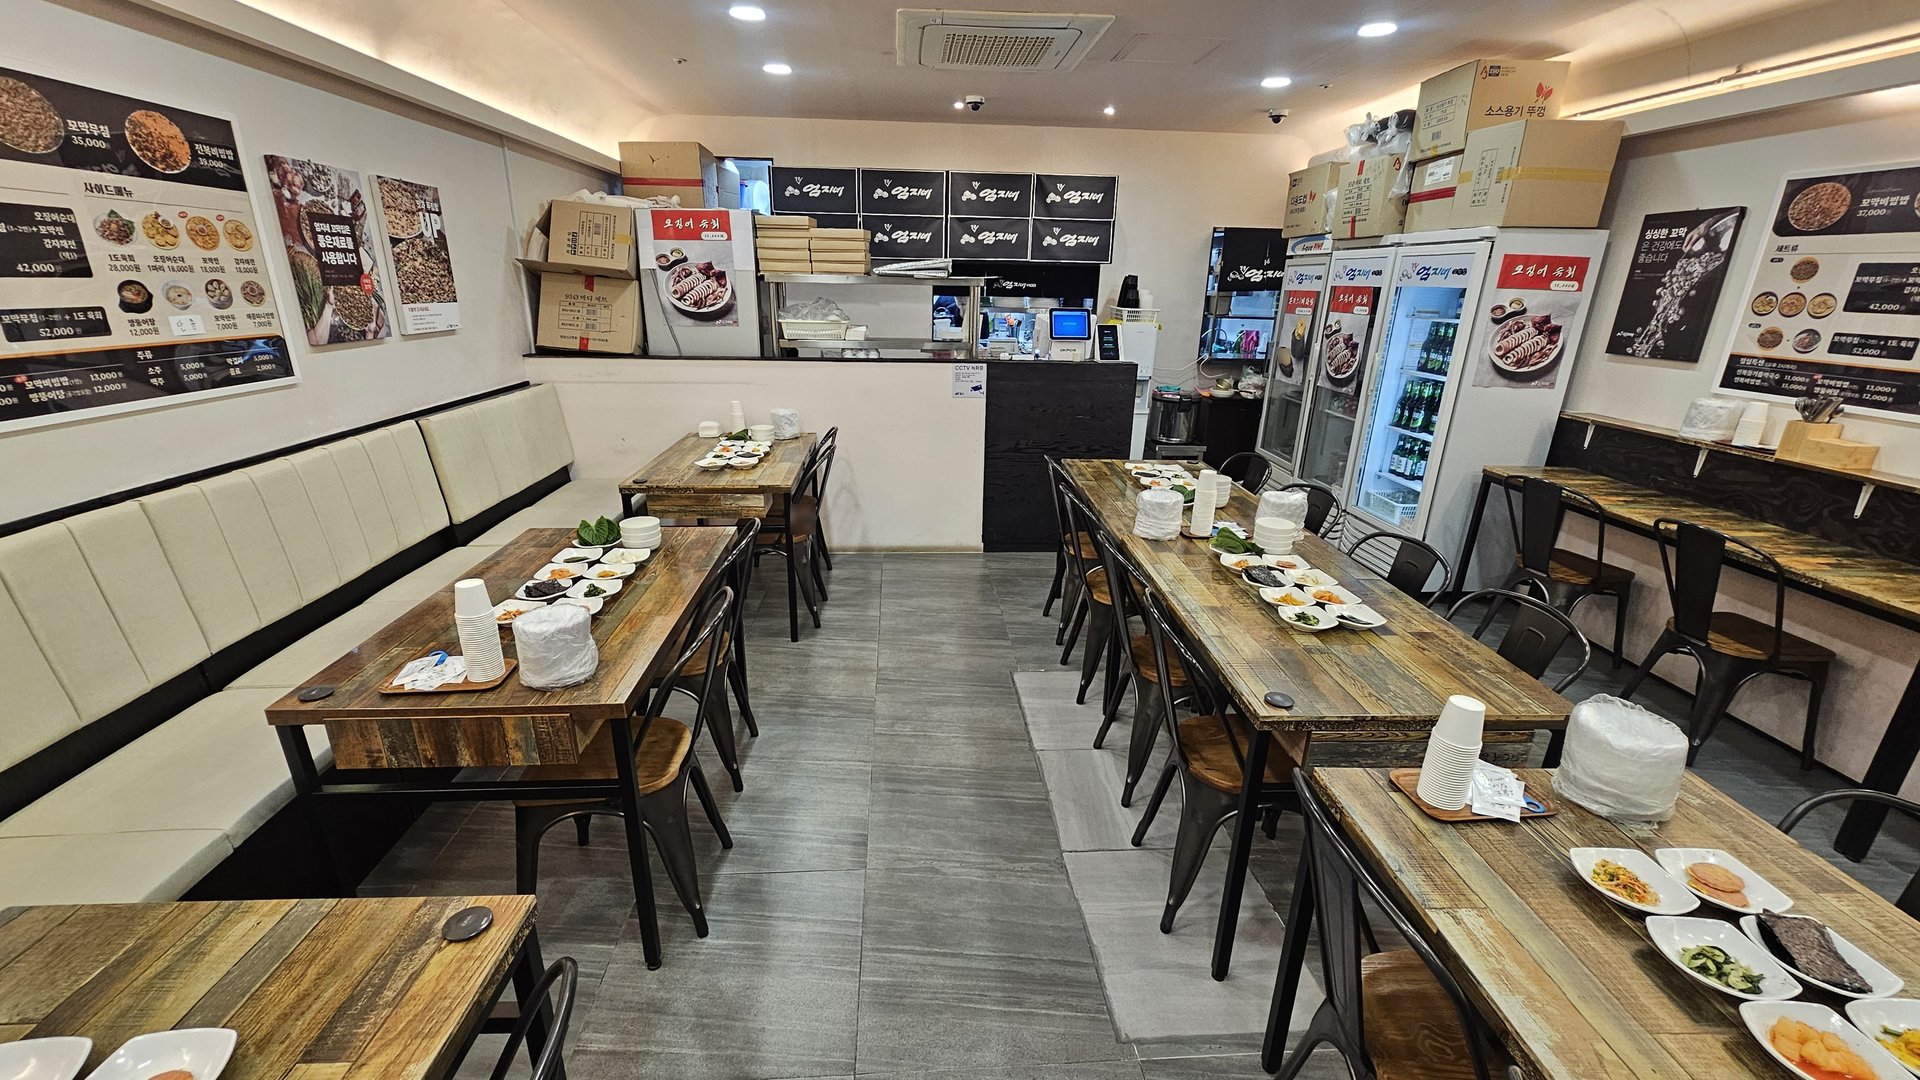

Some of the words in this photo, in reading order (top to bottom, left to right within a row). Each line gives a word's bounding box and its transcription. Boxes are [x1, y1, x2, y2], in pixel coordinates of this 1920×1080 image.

[1484, 105, 1525, 118] 소스용기
[1526, 105, 1547, 118] 뚜껑
[67, 119, 111, 139] 꼬막무침
[194, 143, 234, 161] 전복비빔밥
[84, 182, 133, 198] 사이드메뉴
[802, 183, 845, 197] 엄지네
[891, 186, 933, 200] 엄지네
[978, 188, 1021, 202] 엄지네
[1063, 190, 1106, 204] 엄지네
[1860, 195, 1910, 207] 꼬막비빔밥
[34, 211, 77, 224] 오징어순대
[664, 217, 694, 230] 오징어
[699, 217, 720, 230] 육회
[419, 211, 442, 239] UP
[891, 230, 932, 243] 엄지네
[977, 231, 1019, 245] 엄지네
[1645, 229, 1669, 240] 싱싱한
[1669, 227, 1688, 239] 꼬막
[43, 238, 77, 250] 감자채전
[1059, 234, 1101, 247] 엄지네
[1641, 241, 1651, 252] 은
[1651, 240, 1683, 252] 건강에도
[321, 251, 358, 265] 사용합니다
[1637, 252, 1669, 264] 좋습니다
[108, 264, 141, 273] 28,000원
[167, 265, 195, 273] 18,000원
[1416, 265, 1452, 281] 엄지네
[1511, 264, 1548, 277] 오징어
[1552, 265, 1577, 278] 육회
[129, 327, 160, 337] 12,000원
[136, 350, 153, 361] 주류
[148, 366, 162, 375] 소주
[149, 376, 166, 387] 맥주
